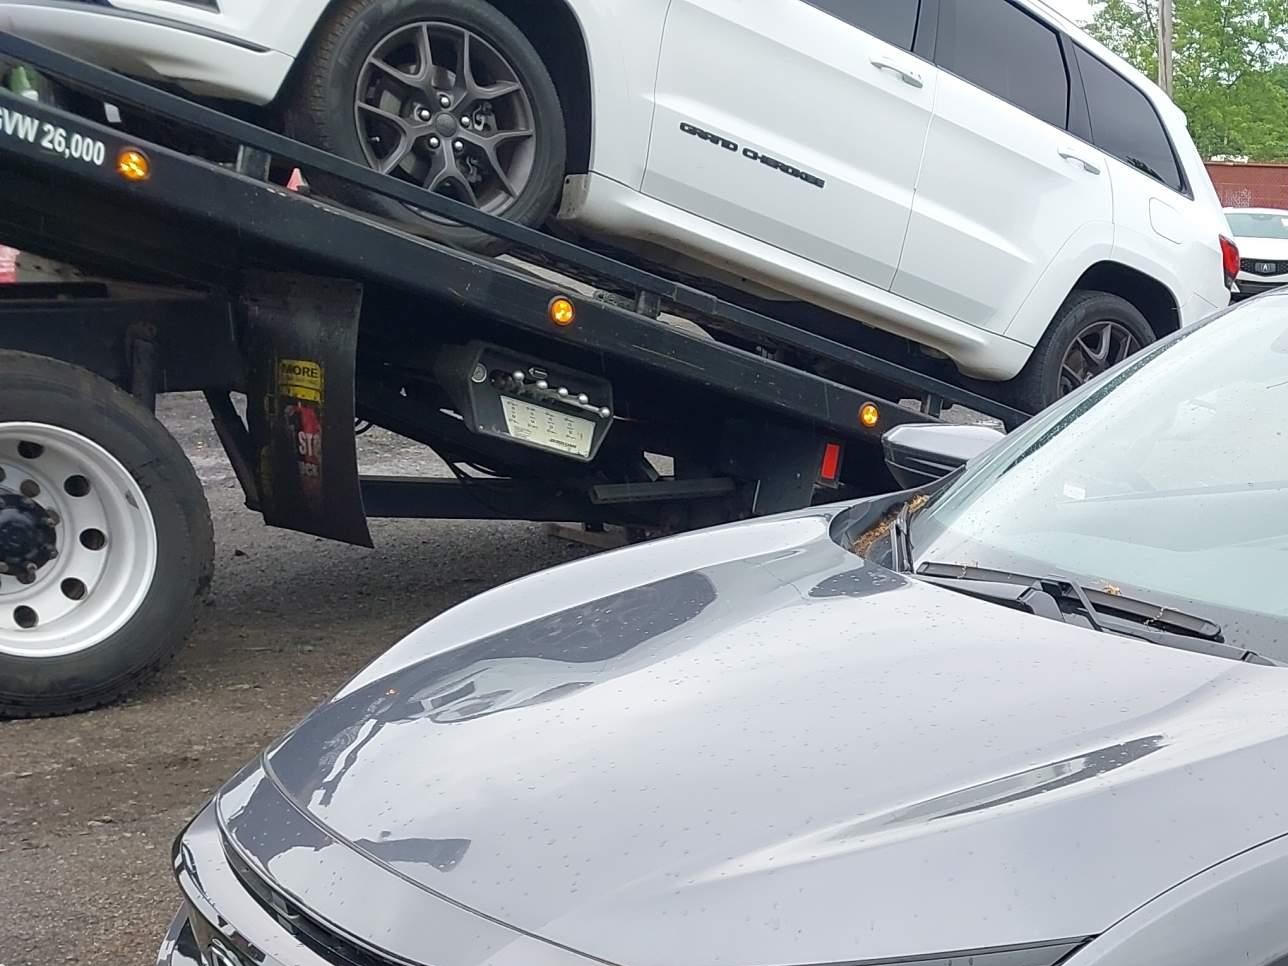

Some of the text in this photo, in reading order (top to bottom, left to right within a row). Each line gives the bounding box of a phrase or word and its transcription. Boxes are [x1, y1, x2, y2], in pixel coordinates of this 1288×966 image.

[0, 106, 105, 166] VW 26,000
[679, 122, 825, 188] GRAND CHEROKEE
